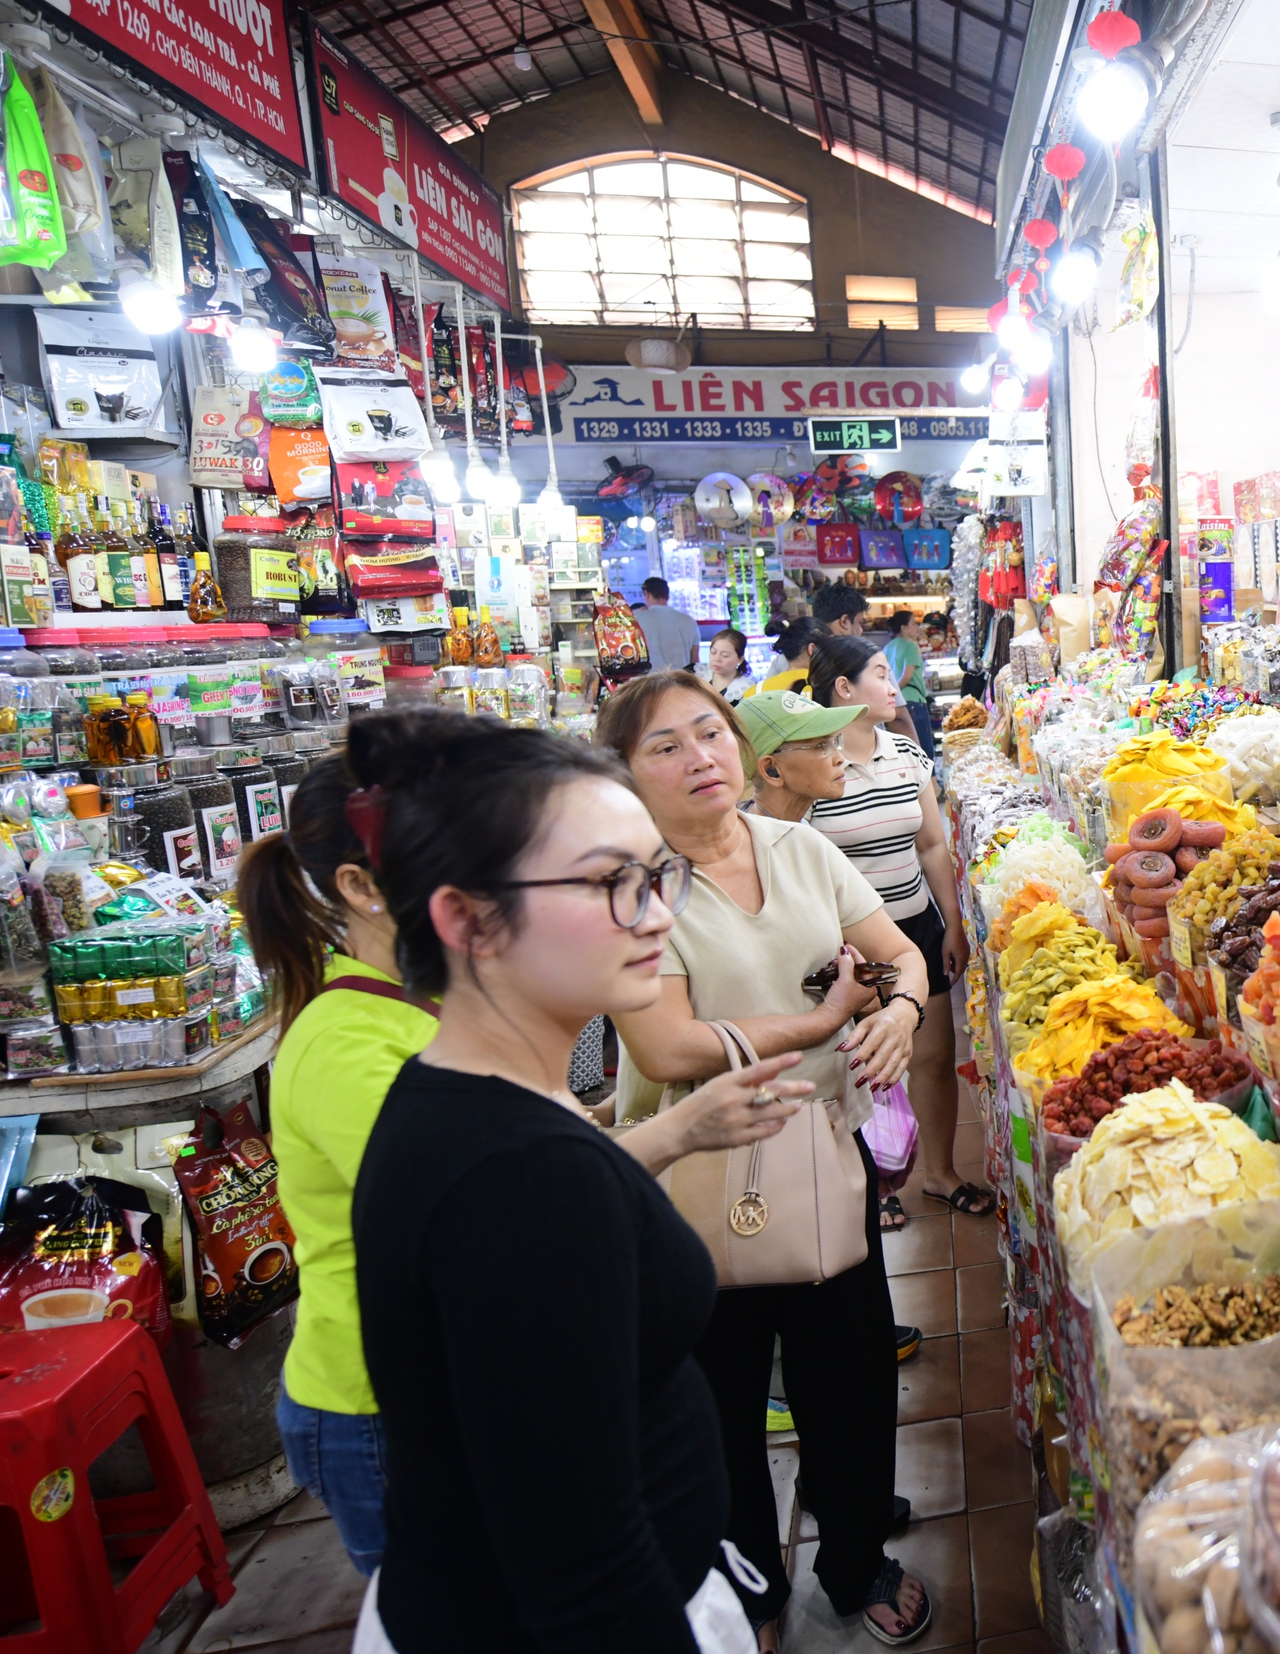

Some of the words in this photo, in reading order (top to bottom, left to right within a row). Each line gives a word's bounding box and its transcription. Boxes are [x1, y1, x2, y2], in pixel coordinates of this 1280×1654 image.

[188, 15, 216, 56] LOẠI
[217, 36, 239, 70] TRÀ
[248, 59, 261, 86] CÀ
[262, 70, 281, 100] PHÊ
[156, 30, 179, 67] CHỢ
[180, 43, 200, 79] BẾN
[200, 60, 235, 104] THÀNH,
[235, 85, 246, 109] Q.
[267, 106, 286, 135] HCM
[438, 161, 452, 181] GIA
[453, 174, 469, 196] ĐÌNH
[413, 162, 448, 220] LIÊN
[451, 195, 474, 242] SÀI
[476, 218, 504, 266] GÒN
[324, 284, 347, 293] onut
[348, 284, 377, 295] Coffee
[76, 347, 127, 358] Classic
[345, 378, 386, 387] Classic
[652, 372, 764, 412] LIÊN
[781, 381, 957, 412] SAIGON
[580, 421, 619, 438] 1329
[633, 421, 669, 437] 1331
[684, 421, 722, 437] 1333
[735, 421, 772, 437] 1335
[301, 432, 311, 440] Q
[816, 431, 841, 442] EXIT
[295, 441, 322, 450] GOOD
[193, 457, 238, 469] LUWAK
[242, 457, 264, 470] 30
[260, 556, 281, 564] Coffee
[349, 660, 367, 669] TRUNG
[367, 658, 383, 669] NGUYÊ
[202, 689, 224, 703] GREEN
[155, 699, 186, 714] JASMINE
[257, 793, 275, 801] Coffee
[214, 814, 236, 825] Coffee
[212, 1217, 231, 1234] Cà
[231, 1208, 251, 1228] phê
[735, 1206, 763, 1226] MK
[117, 1260, 136, 1268] NEW
